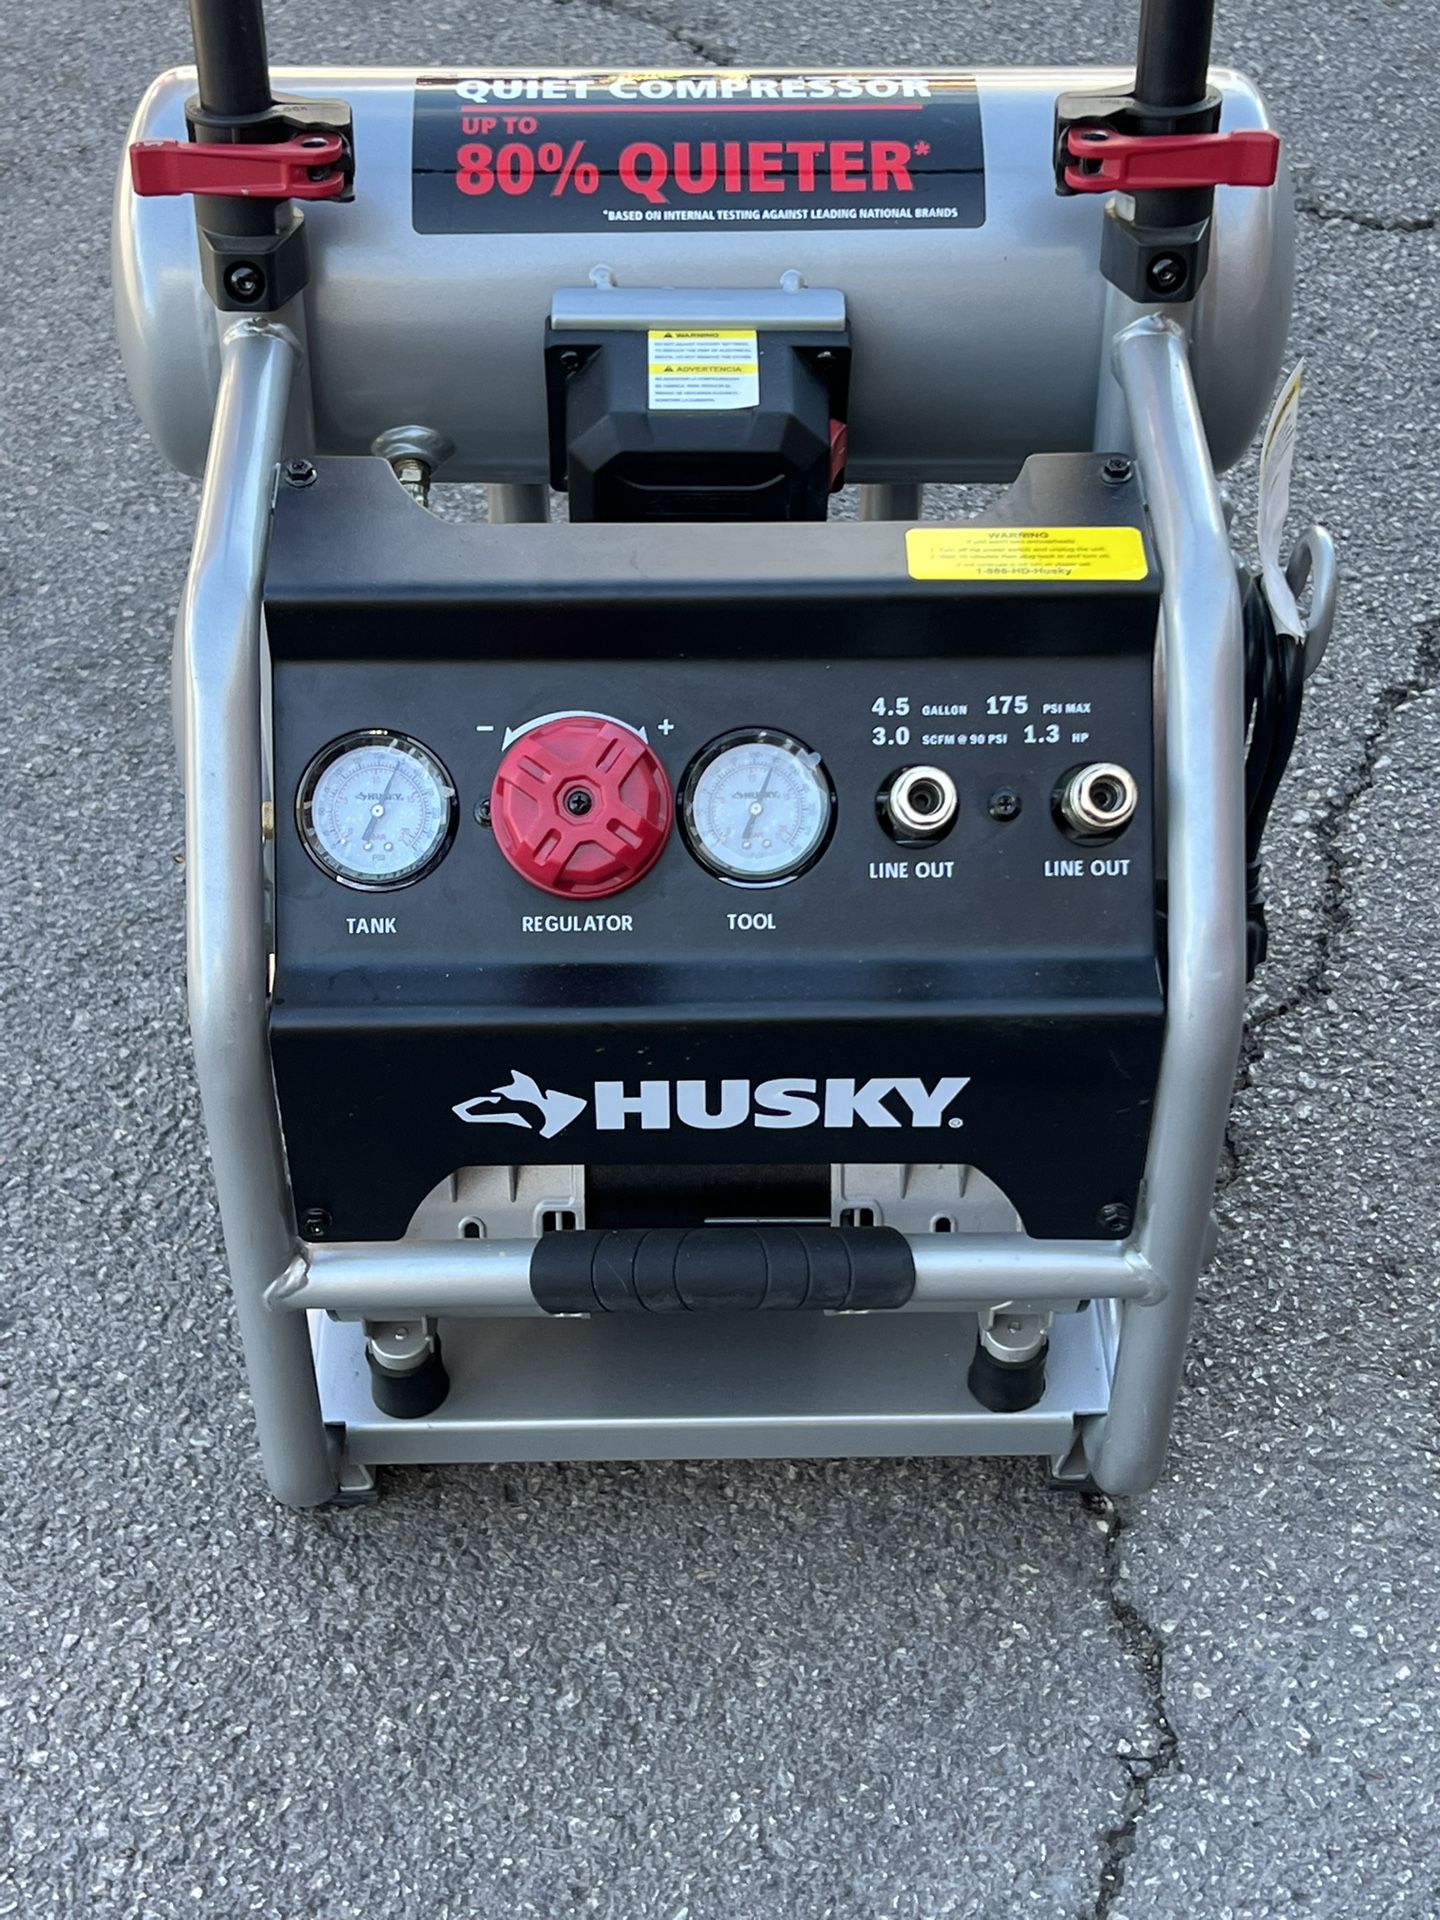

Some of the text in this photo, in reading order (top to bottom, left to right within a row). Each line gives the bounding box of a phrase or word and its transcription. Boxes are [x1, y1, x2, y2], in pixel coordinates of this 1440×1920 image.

[455, 78, 932, 103] QUIET COMPRESSOR
[462, 116, 538, 135] UP TO
[455, 140, 600, 197] 80%
[645, 210, 662, 221] ON
[663, 209, 716, 221] INTERNAL
[717, 209, 760, 220] TESTING
[762, 208, 808, 220] AGAINST
[810, 208, 858, 219] LEADING
[859, 207, 913, 219] NATIONAL
[914, 207, 959, 218] BRANDS
[871, 695, 1091, 716] 4.5 GALLON 175 PSI MAX
[872, 724, 1089, 746] 3.0 SCFM @ 90 PSI 1.3 HP
[869, 861, 955, 879] LINE OUT
[1044, 859, 1130, 877] LINE OUT
[346, 917, 398, 934] TANK
[522, 915, 633, 932] REGULATOR
[727, 913, 777, 930] TOOL
[594, 1077, 971, 1130] HUSKY
